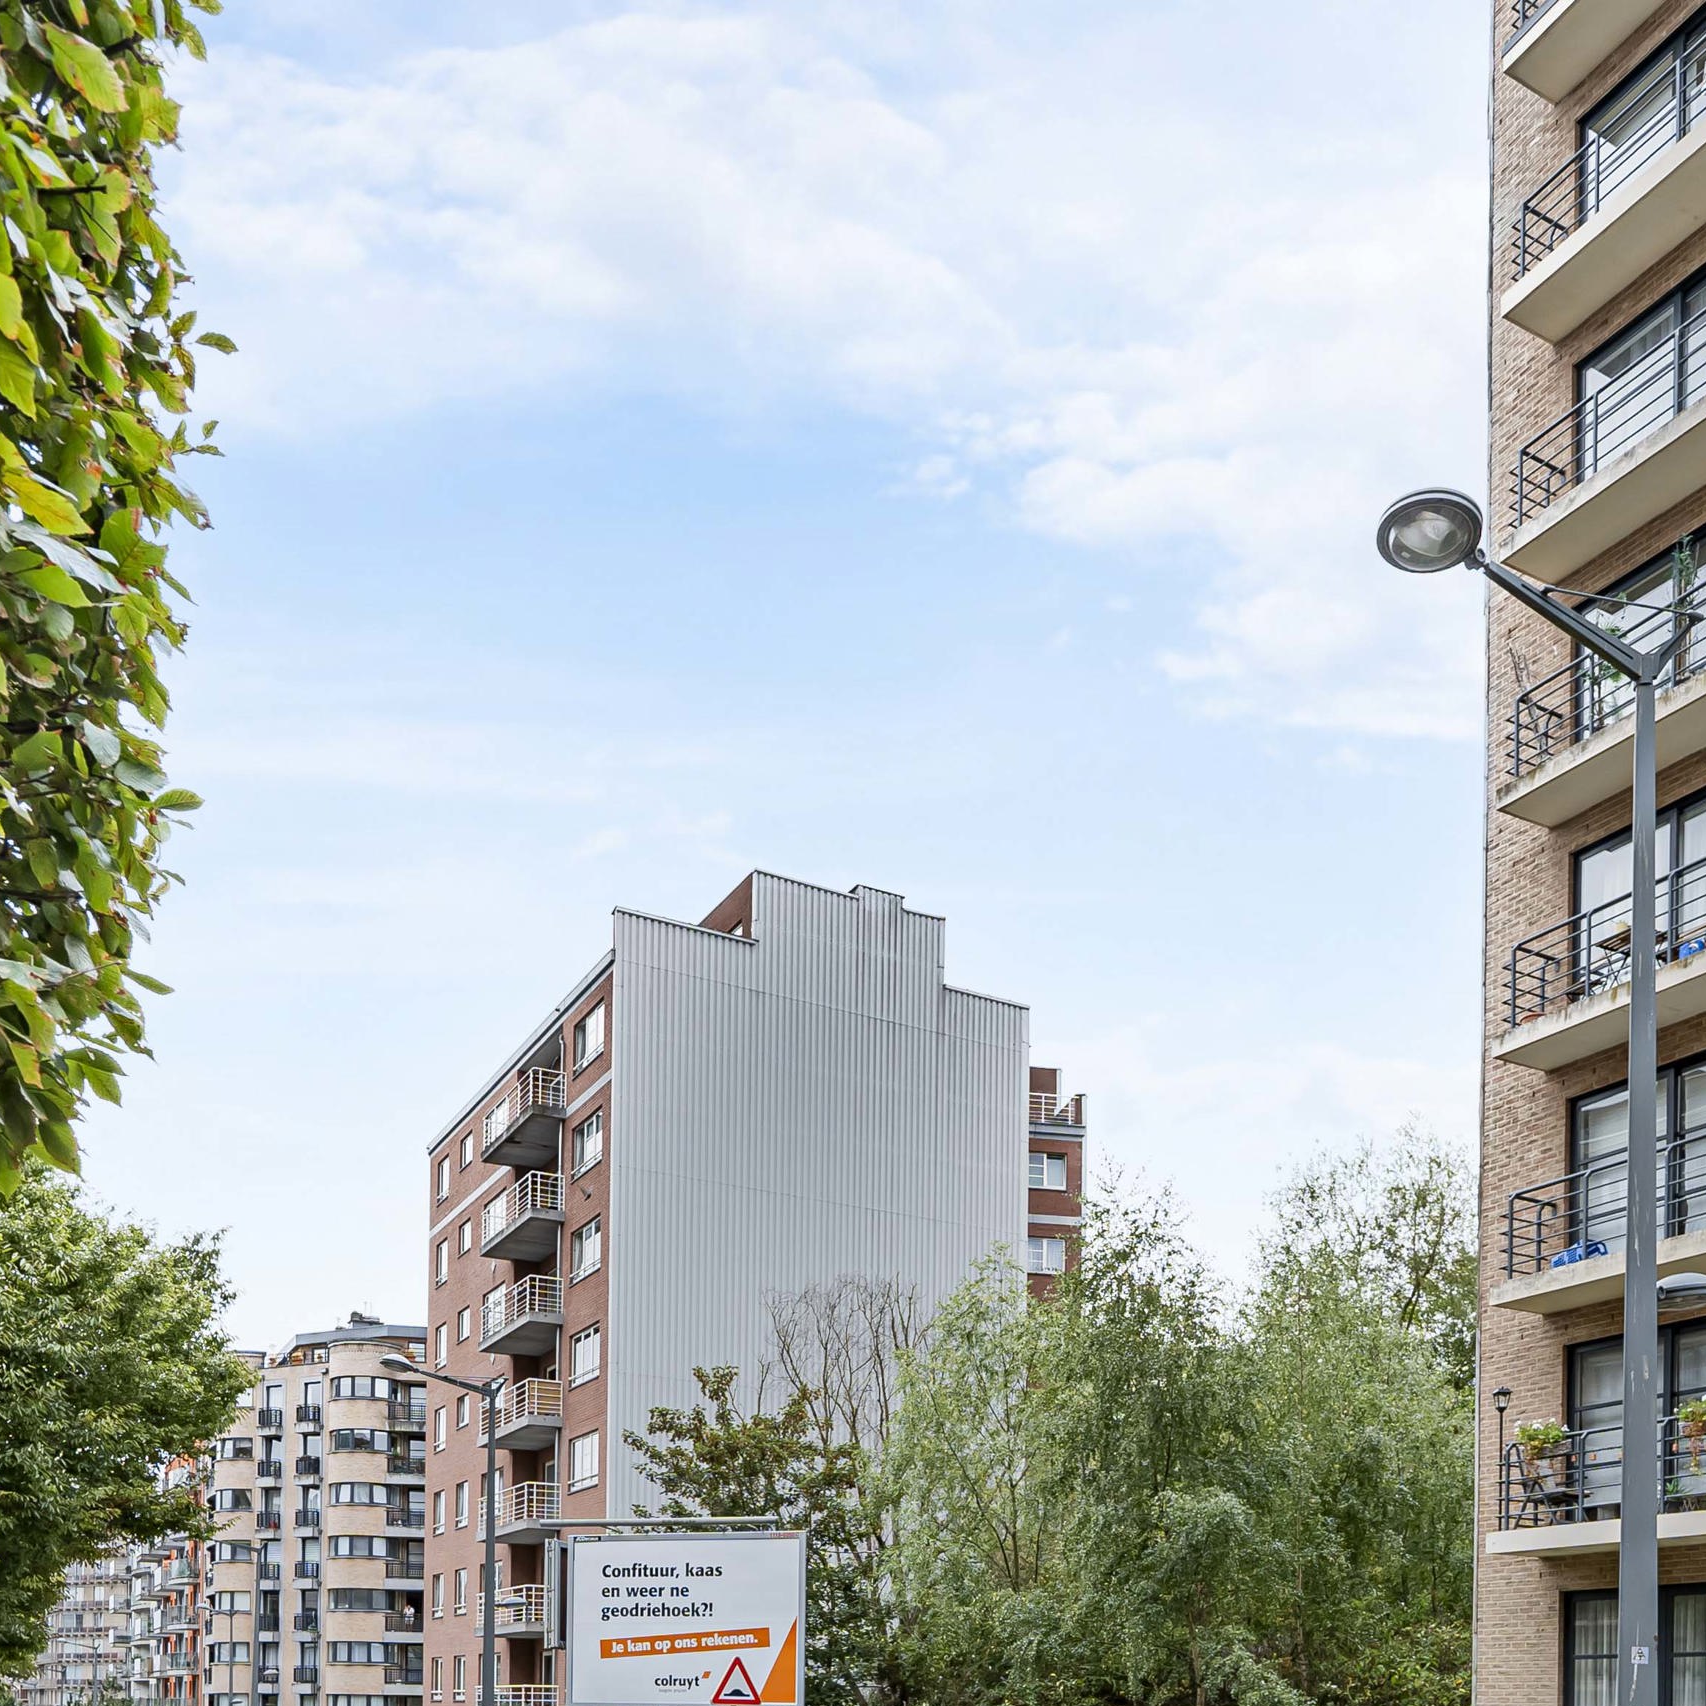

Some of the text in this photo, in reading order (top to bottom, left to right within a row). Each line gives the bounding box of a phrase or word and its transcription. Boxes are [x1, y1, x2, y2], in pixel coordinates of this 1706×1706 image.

[602, 1562, 723, 1579] Confituur, kaas
[601, 1586, 689, 1598] en weer ne
[601, 1602, 713, 1621] geodriehoek?!
[611, 1633, 758, 1654] Je kan op ons rekenen.
[655, 1674, 700, 1690] colruyt
